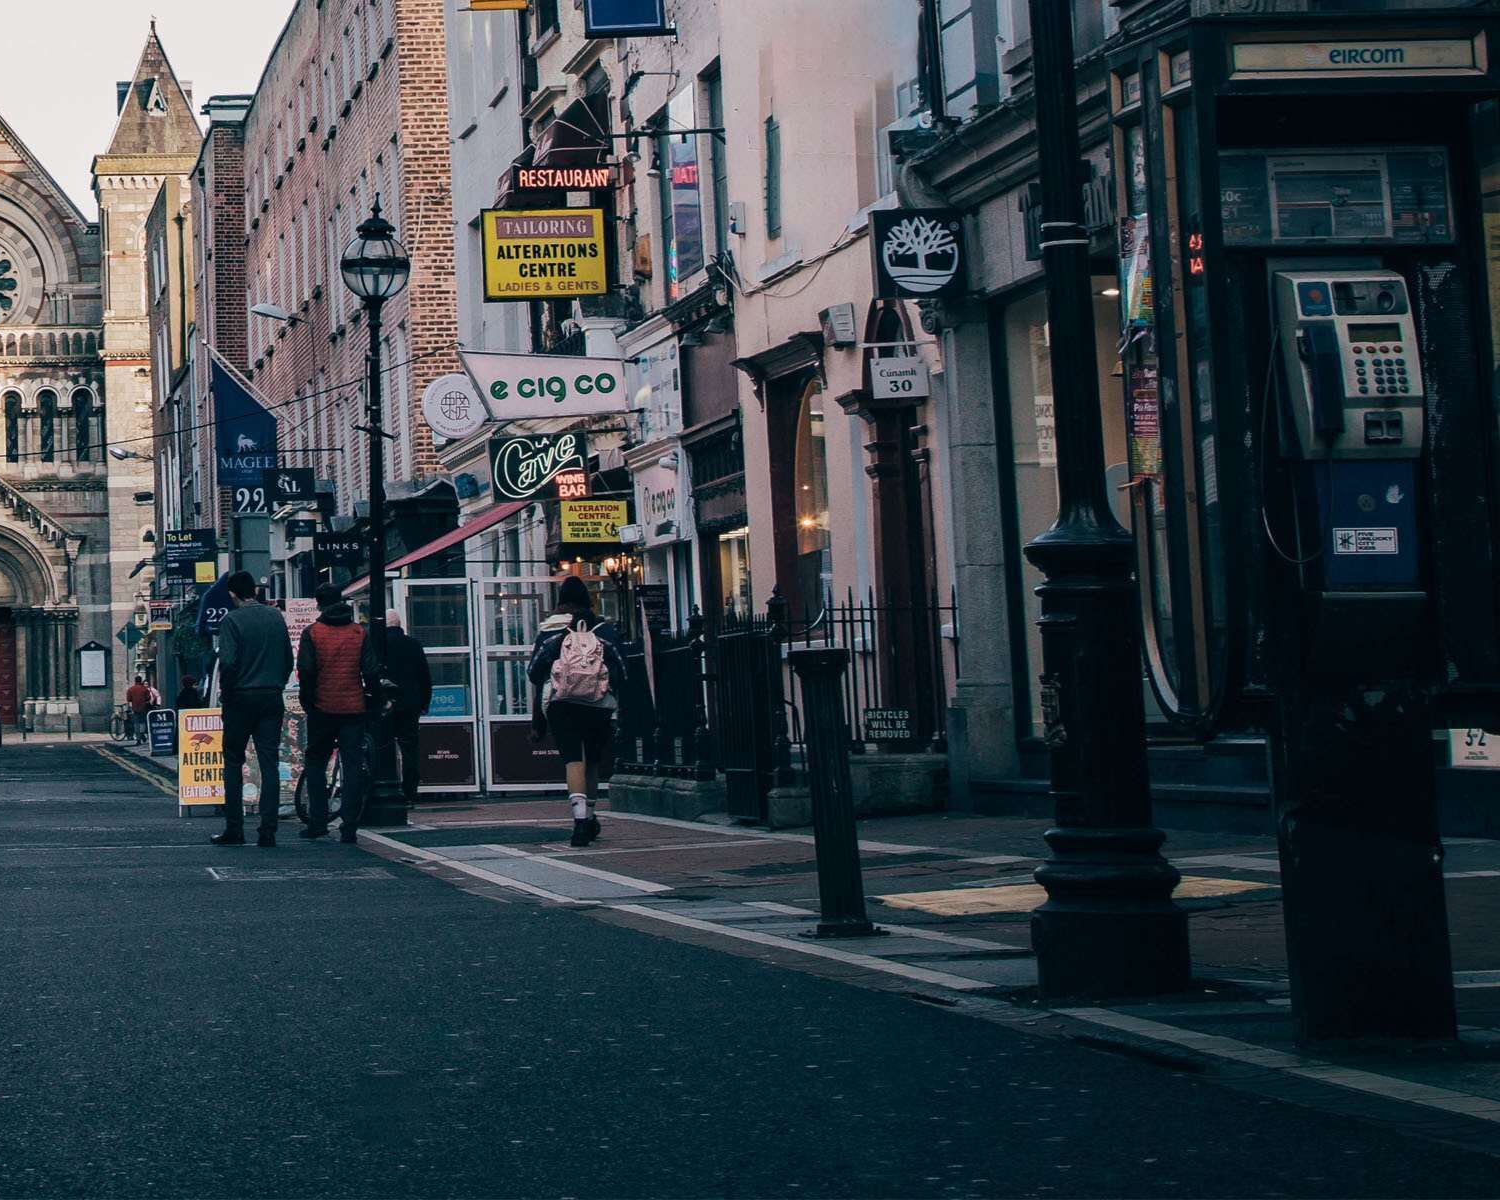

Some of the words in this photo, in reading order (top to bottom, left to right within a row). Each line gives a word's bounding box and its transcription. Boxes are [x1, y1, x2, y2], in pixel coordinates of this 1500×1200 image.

[519, 168, 609, 188] RESTAURANT
[502, 219, 588, 236] TAILORING
[496, 243, 599, 260] ALTERATIONS
[518, 262, 577, 278] CENTRE
[497, 281, 541, 292] LADIES
[545, 281, 553, 291] &
[558, 280, 599, 291] GENTS
[490, 380, 509, 400] e
[889, 379, 912, 392] 30
[535, 437, 550, 448] LA
[220, 456, 274, 469] MAGEE
[494, 434, 576, 498] Cave
[560, 484, 587, 497] BAR
[236, 487, 268, 513] 22
[568, 504, 620, 512] ALTERATION
[578, 512, 612, 520] CENTRE
[166, 533, 177, 542] To
[178, 533, 193, 541] Let
[318, 542, 360, 551] LINKS
[205, 607, 229, 623] 22
[867, 710, 910, 719] BICYCLES
[871, 720, 894, 729] WILL
[895, 720, 908, 729] BE
[868, 729, 911, 739] REMOVED
